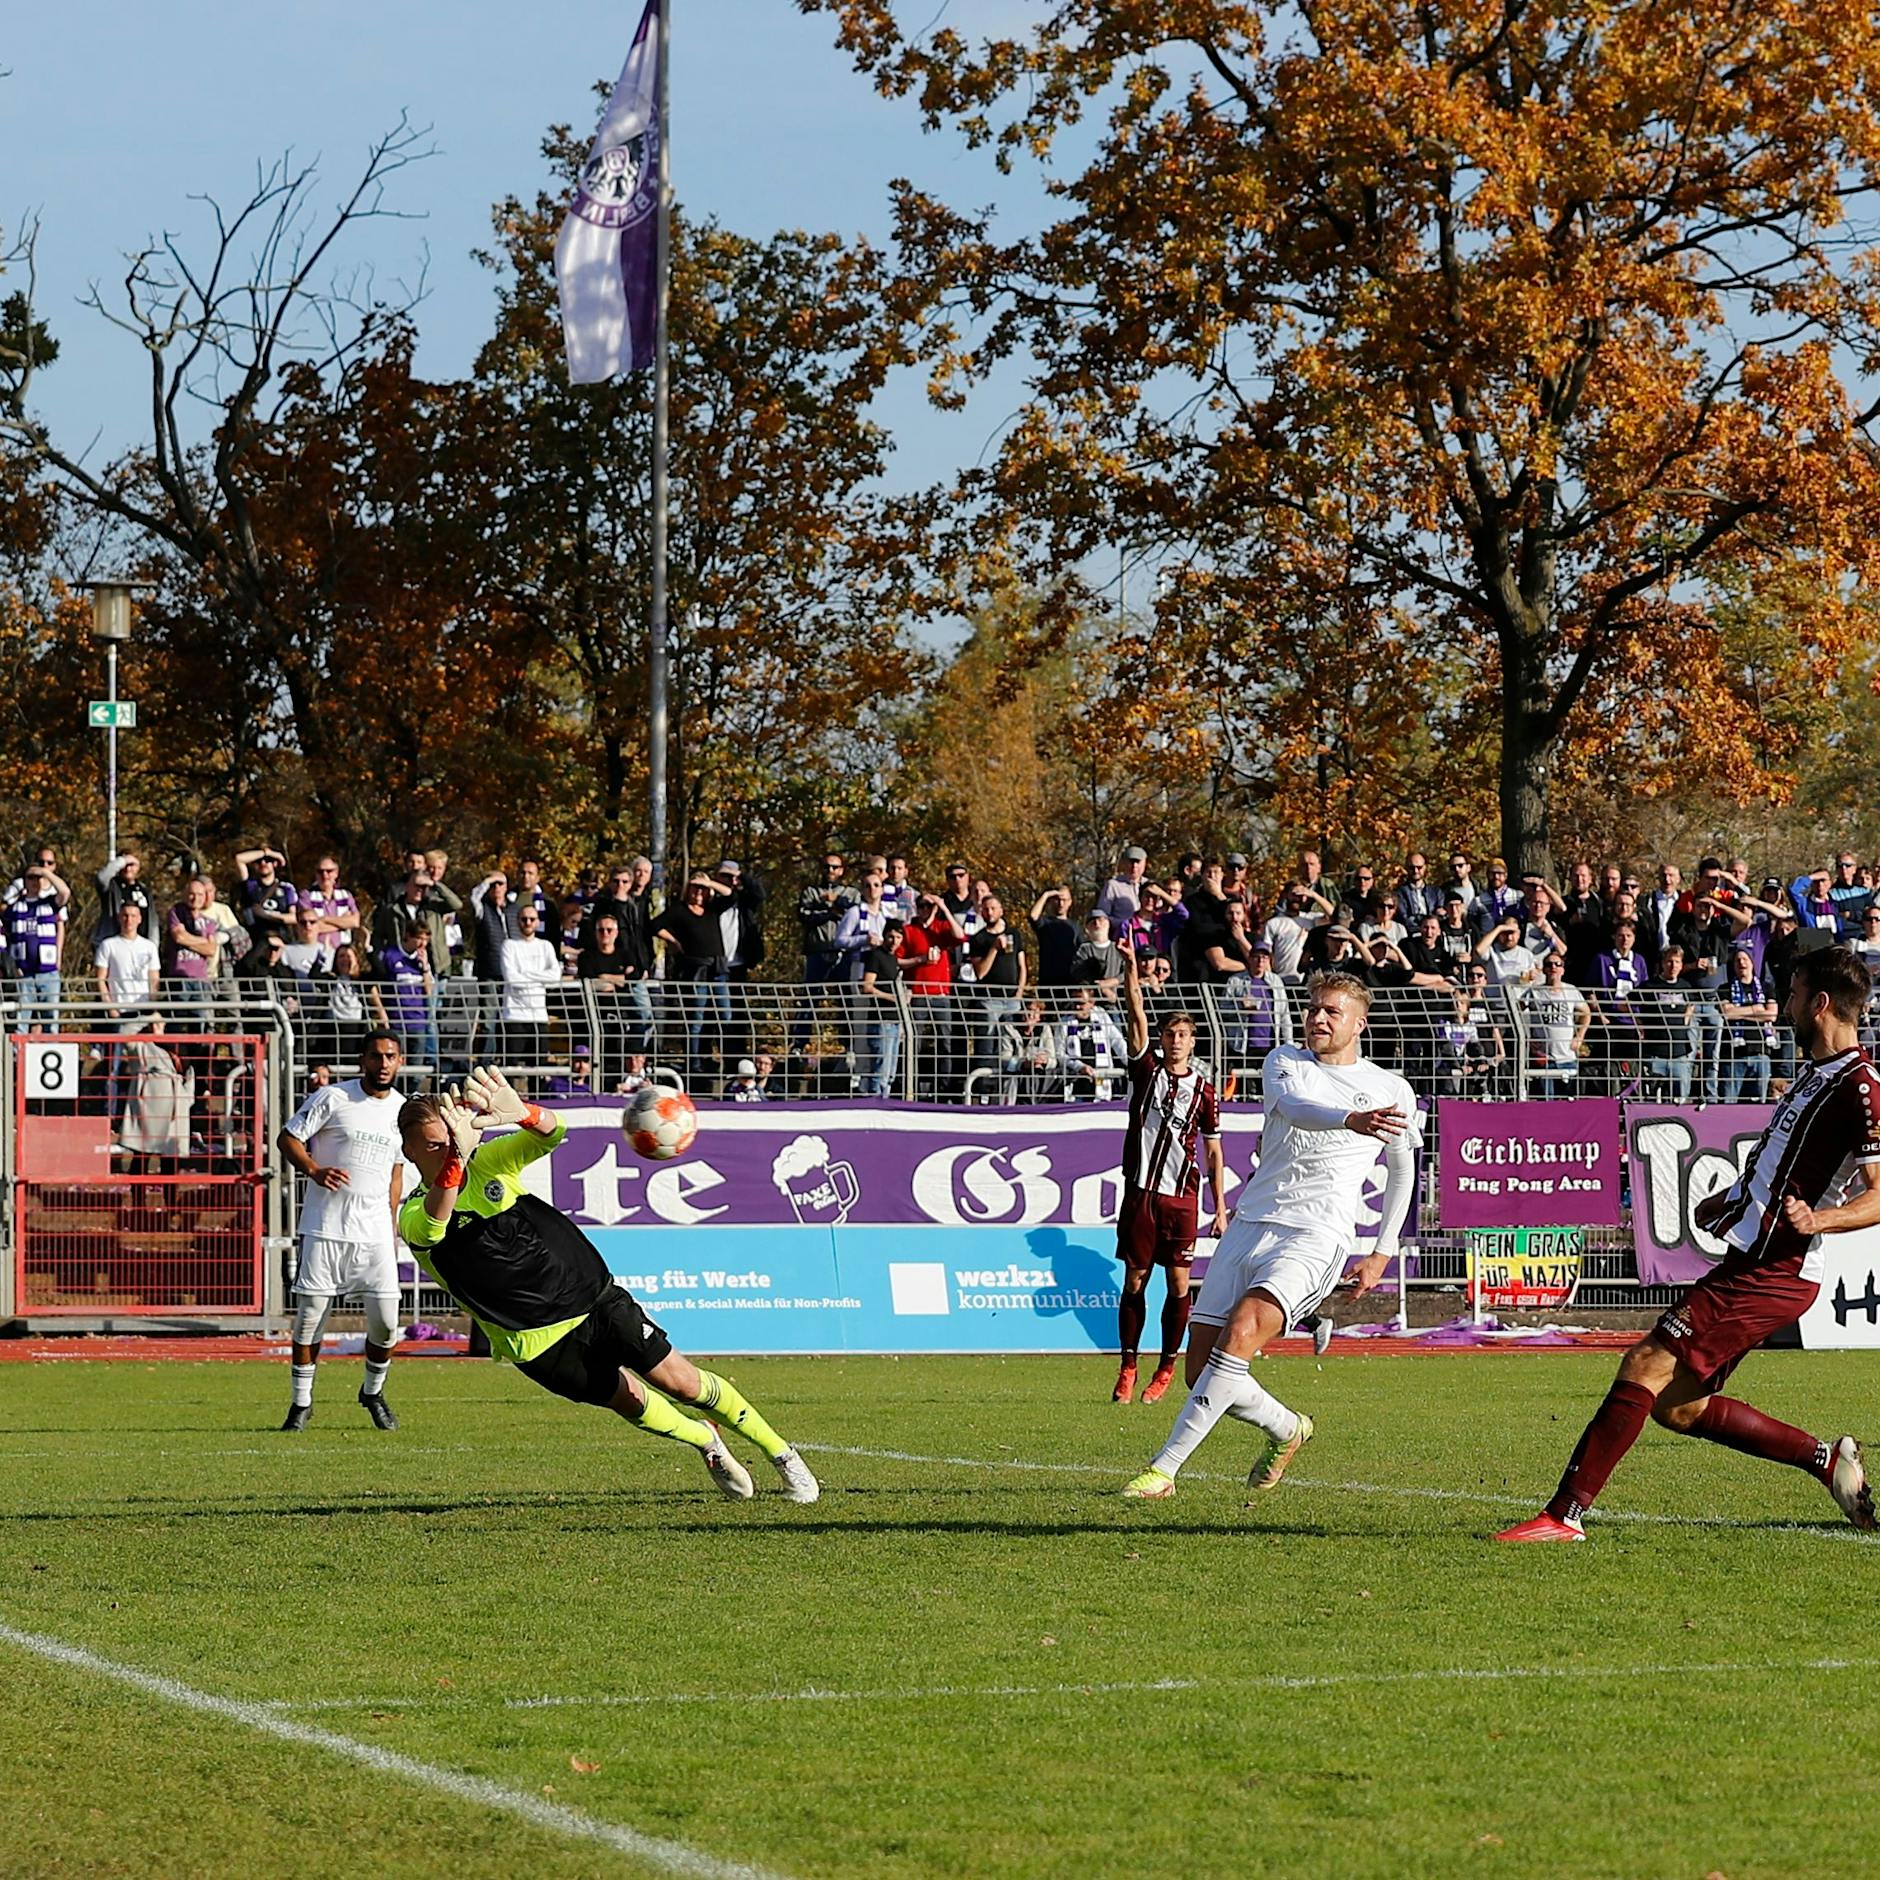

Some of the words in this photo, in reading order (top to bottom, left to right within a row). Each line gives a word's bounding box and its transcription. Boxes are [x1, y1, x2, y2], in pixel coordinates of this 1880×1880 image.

[40, 1050, 63, 1090] 8
[1460, 1137, 1600, 1170] Eichkamp
[1458, 1176, 1501, 1195] Ping
[1506, 1177, 1554, 1194] Pong
[1558, 1175, 1602, 1191] Area
[1636, 1120, 1760, 1257] Te
[1528, 1231, 1581, 1258] GRAS
[662, 1270, 698, 1289] für
[702, 1271, 771, 1289] Werte
[955, 1264, 1058, 1288] werk21
[1479, 1264, 1510, 1289] ÜR
[1522, 1264, 1578, 1289] NAZIS
[685, 1299, 696, 1309] &
[698, 1299, 732, 1309] Social
[735, 1298, 772, 1309] Media
[774, 1298, 792, 1308] für
[794, 1298, 861, 1309] Non-Profits
